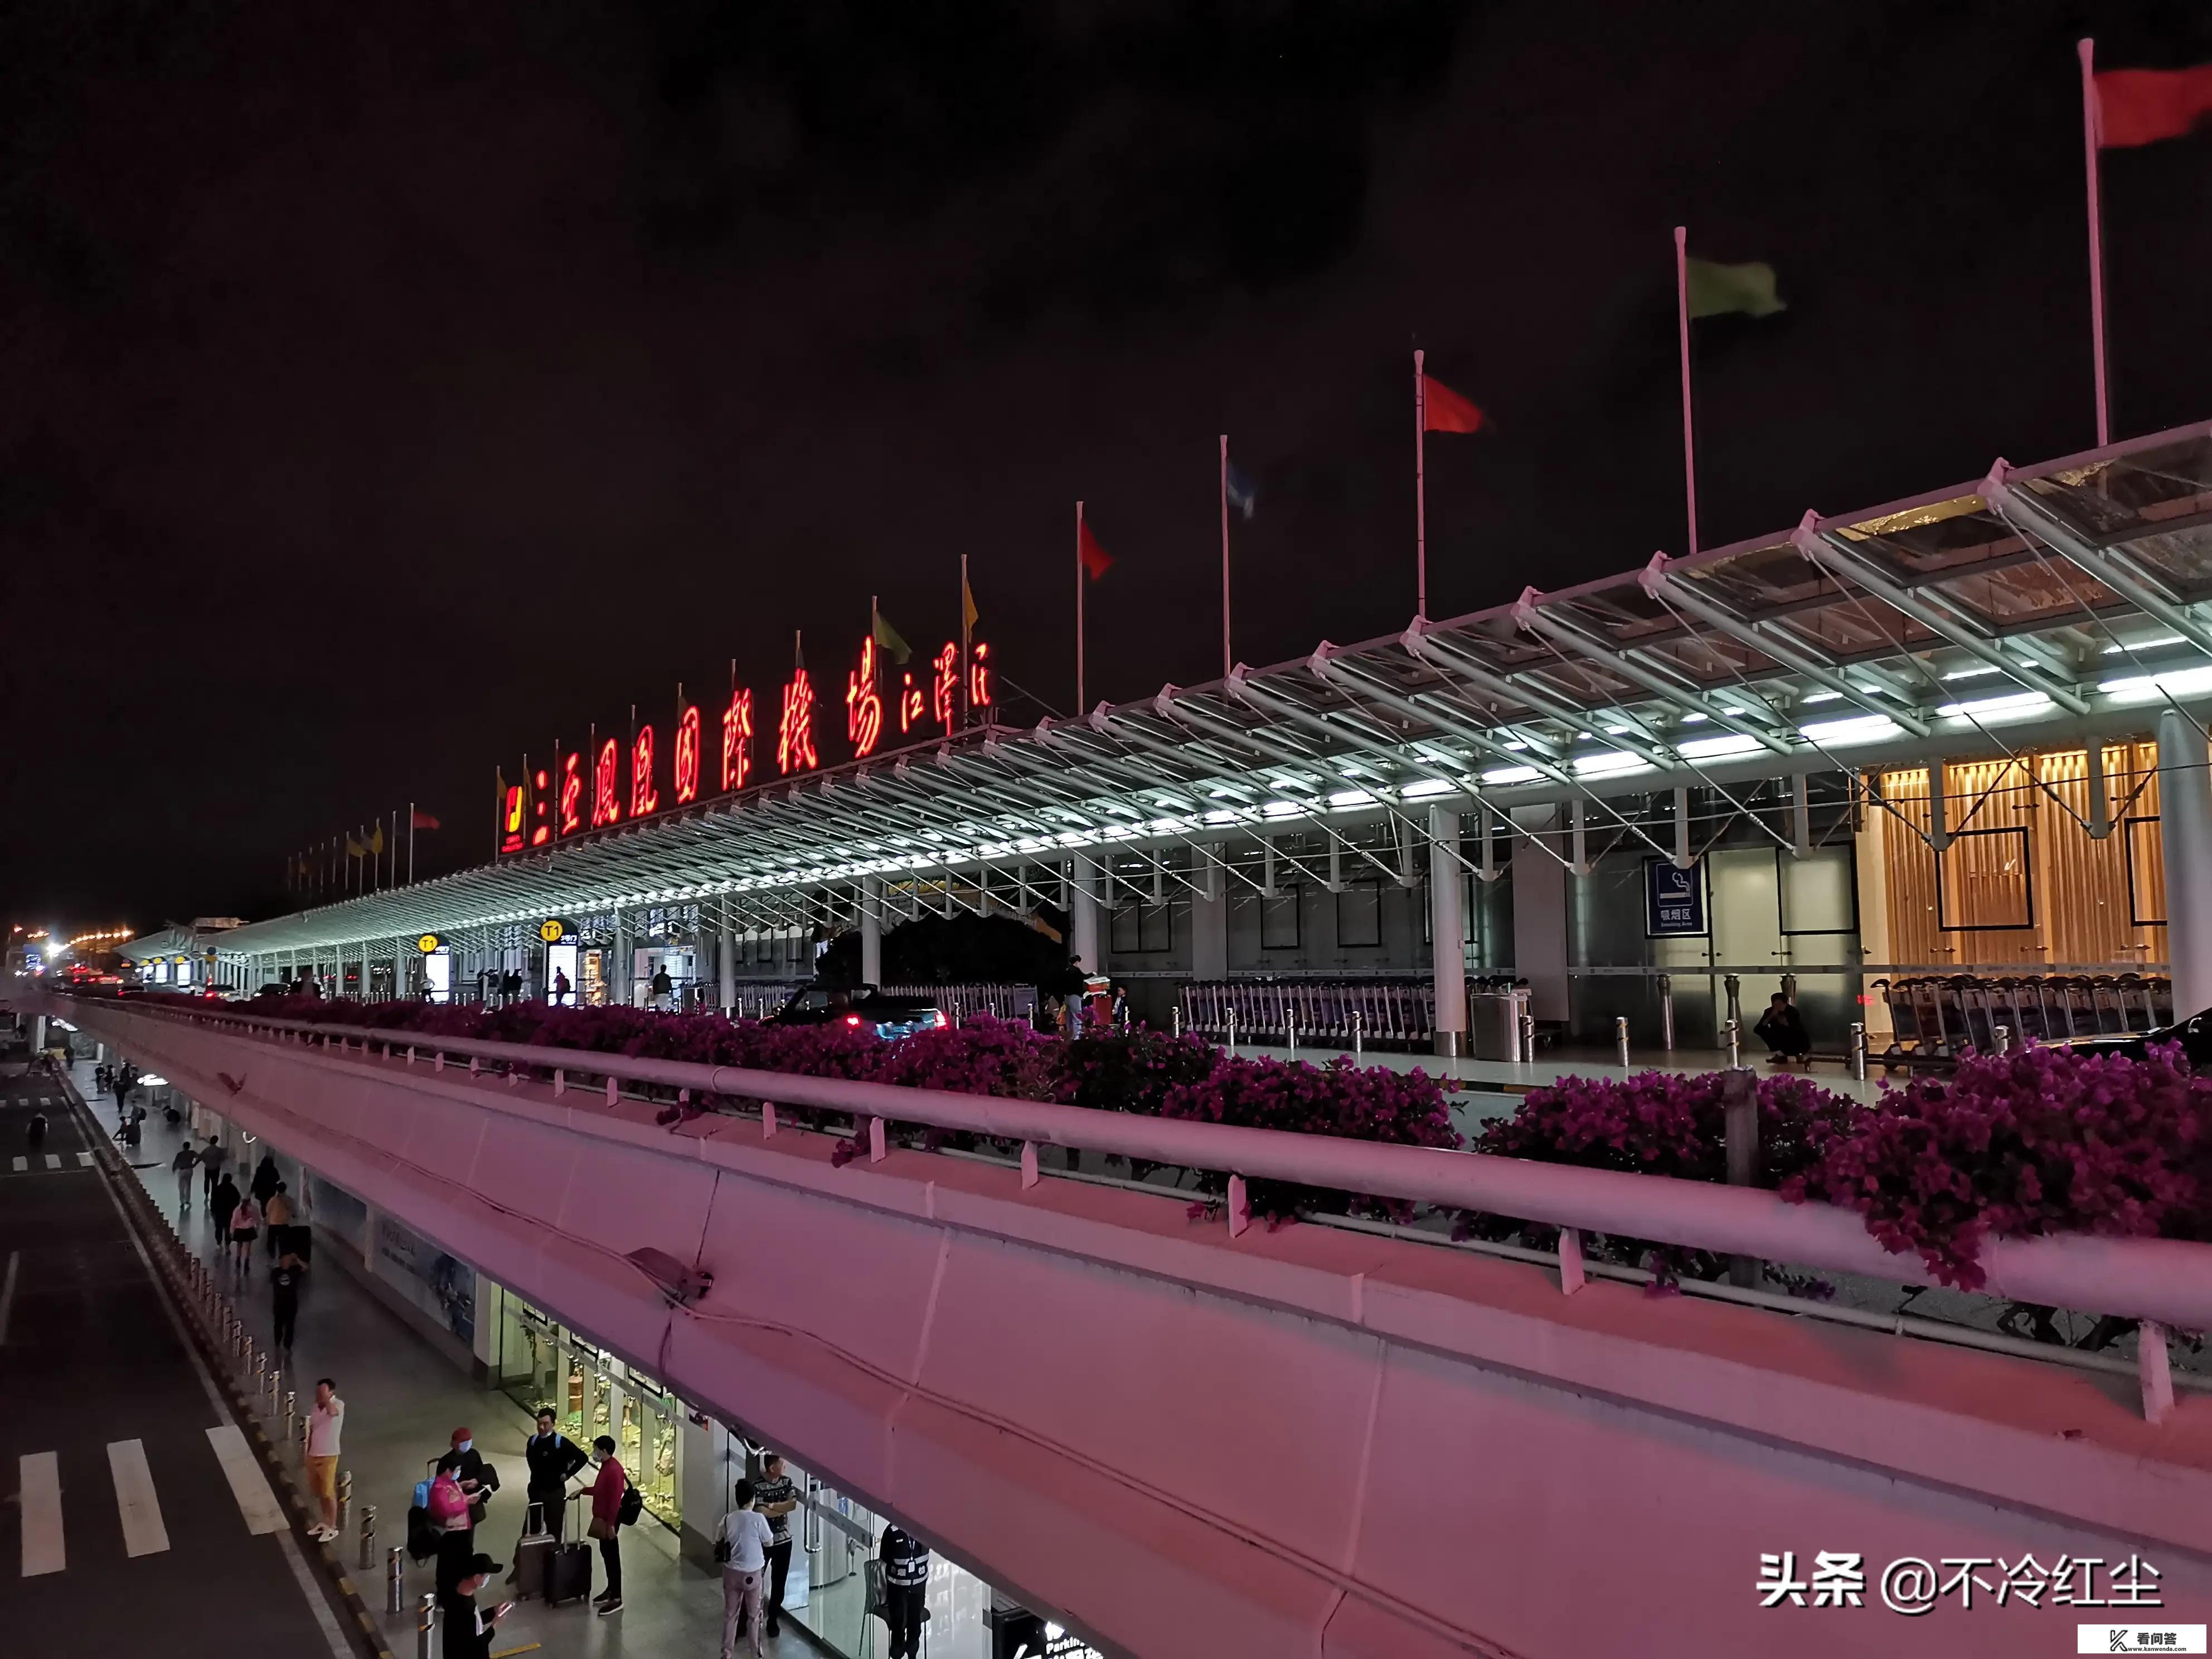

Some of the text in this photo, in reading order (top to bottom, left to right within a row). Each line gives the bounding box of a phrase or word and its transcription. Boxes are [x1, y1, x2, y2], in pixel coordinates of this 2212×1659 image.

[1661, 909, 1691, 920] 吸烟区
[545, 925, 559, 937] T1
[421, 939, 434, 948] T1
